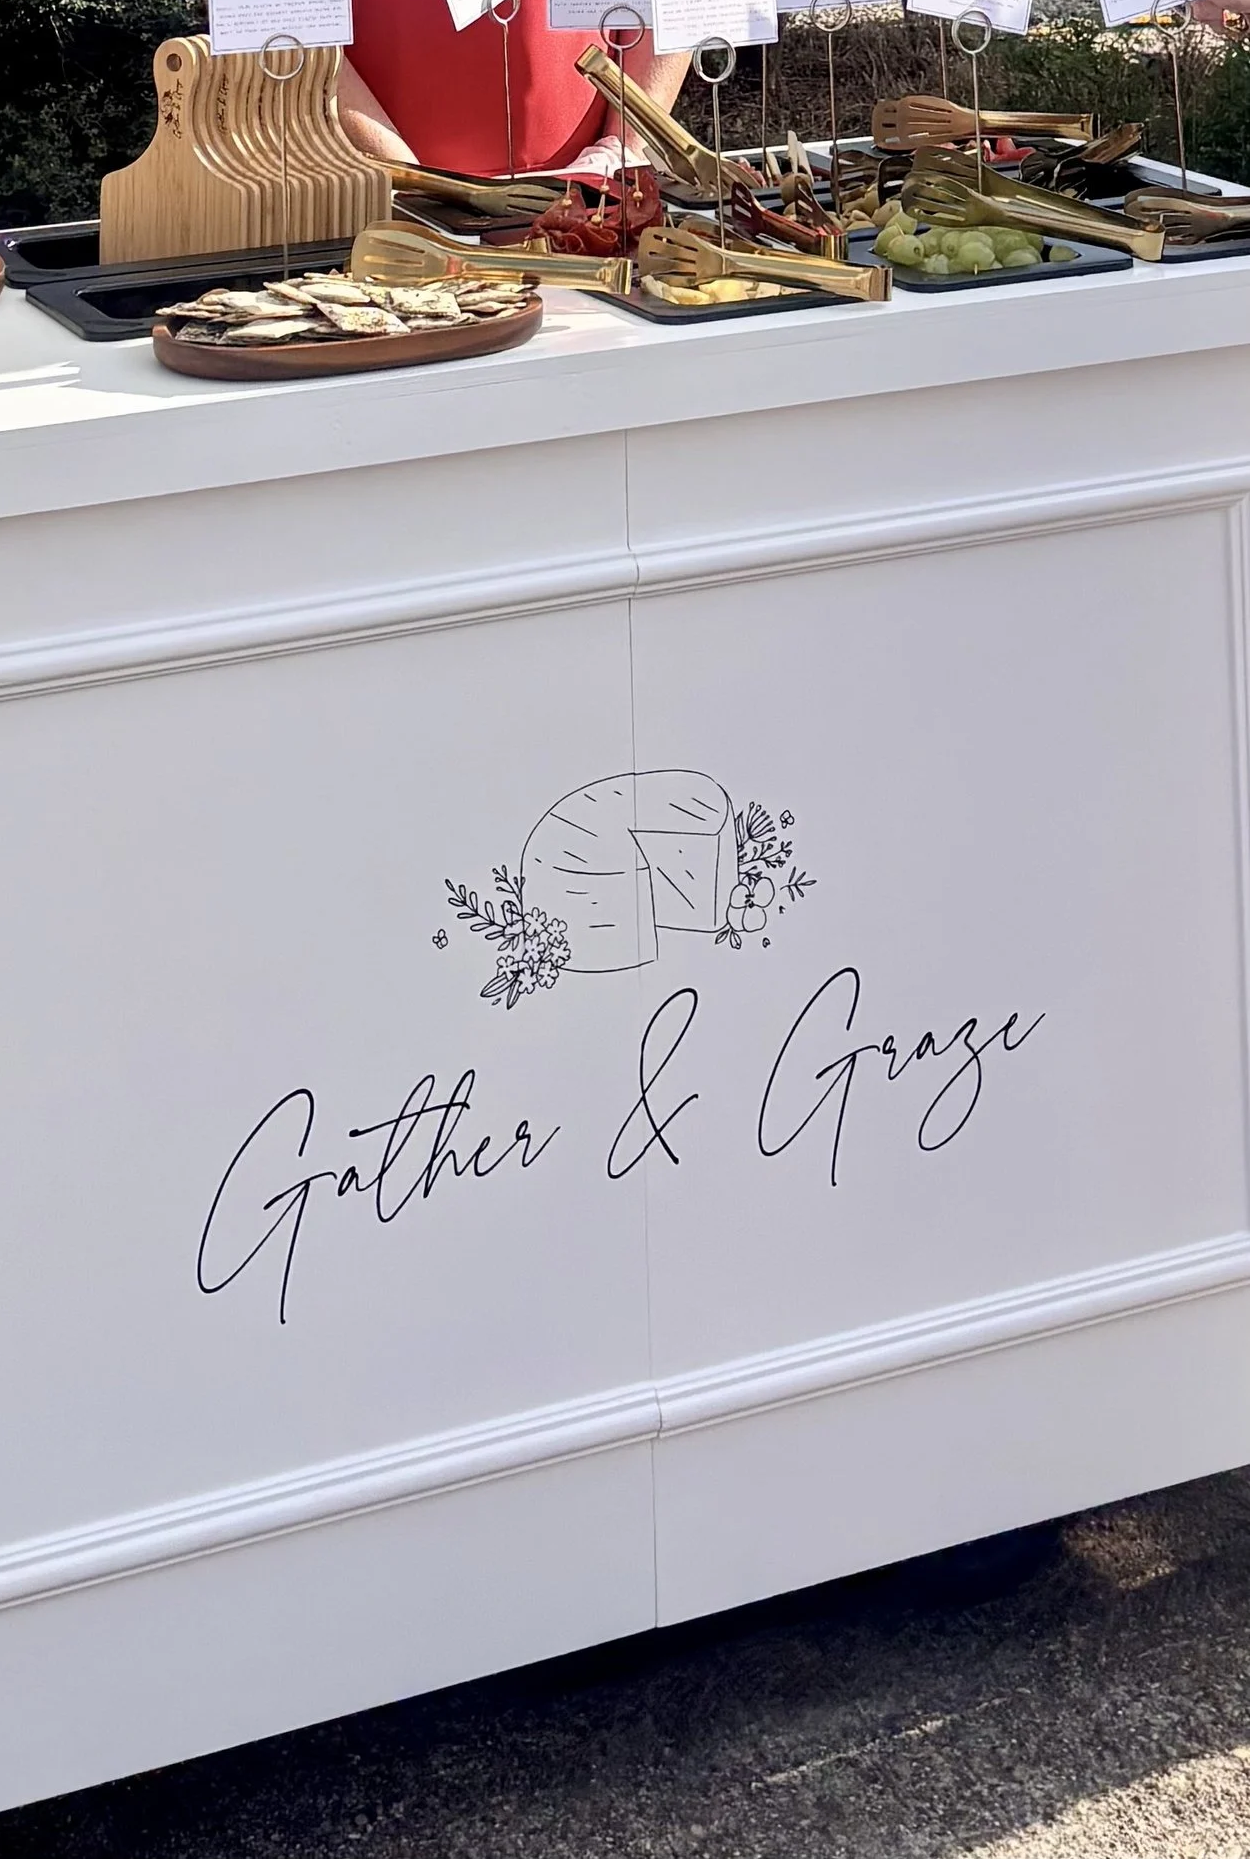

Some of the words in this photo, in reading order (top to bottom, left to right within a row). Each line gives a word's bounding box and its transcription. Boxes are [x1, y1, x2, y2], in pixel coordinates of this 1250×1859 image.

[196, 1069, 561, 1325] Gather
[607, 987, 699, 1179] &
[758, 966, 1046, 1188] Graze
